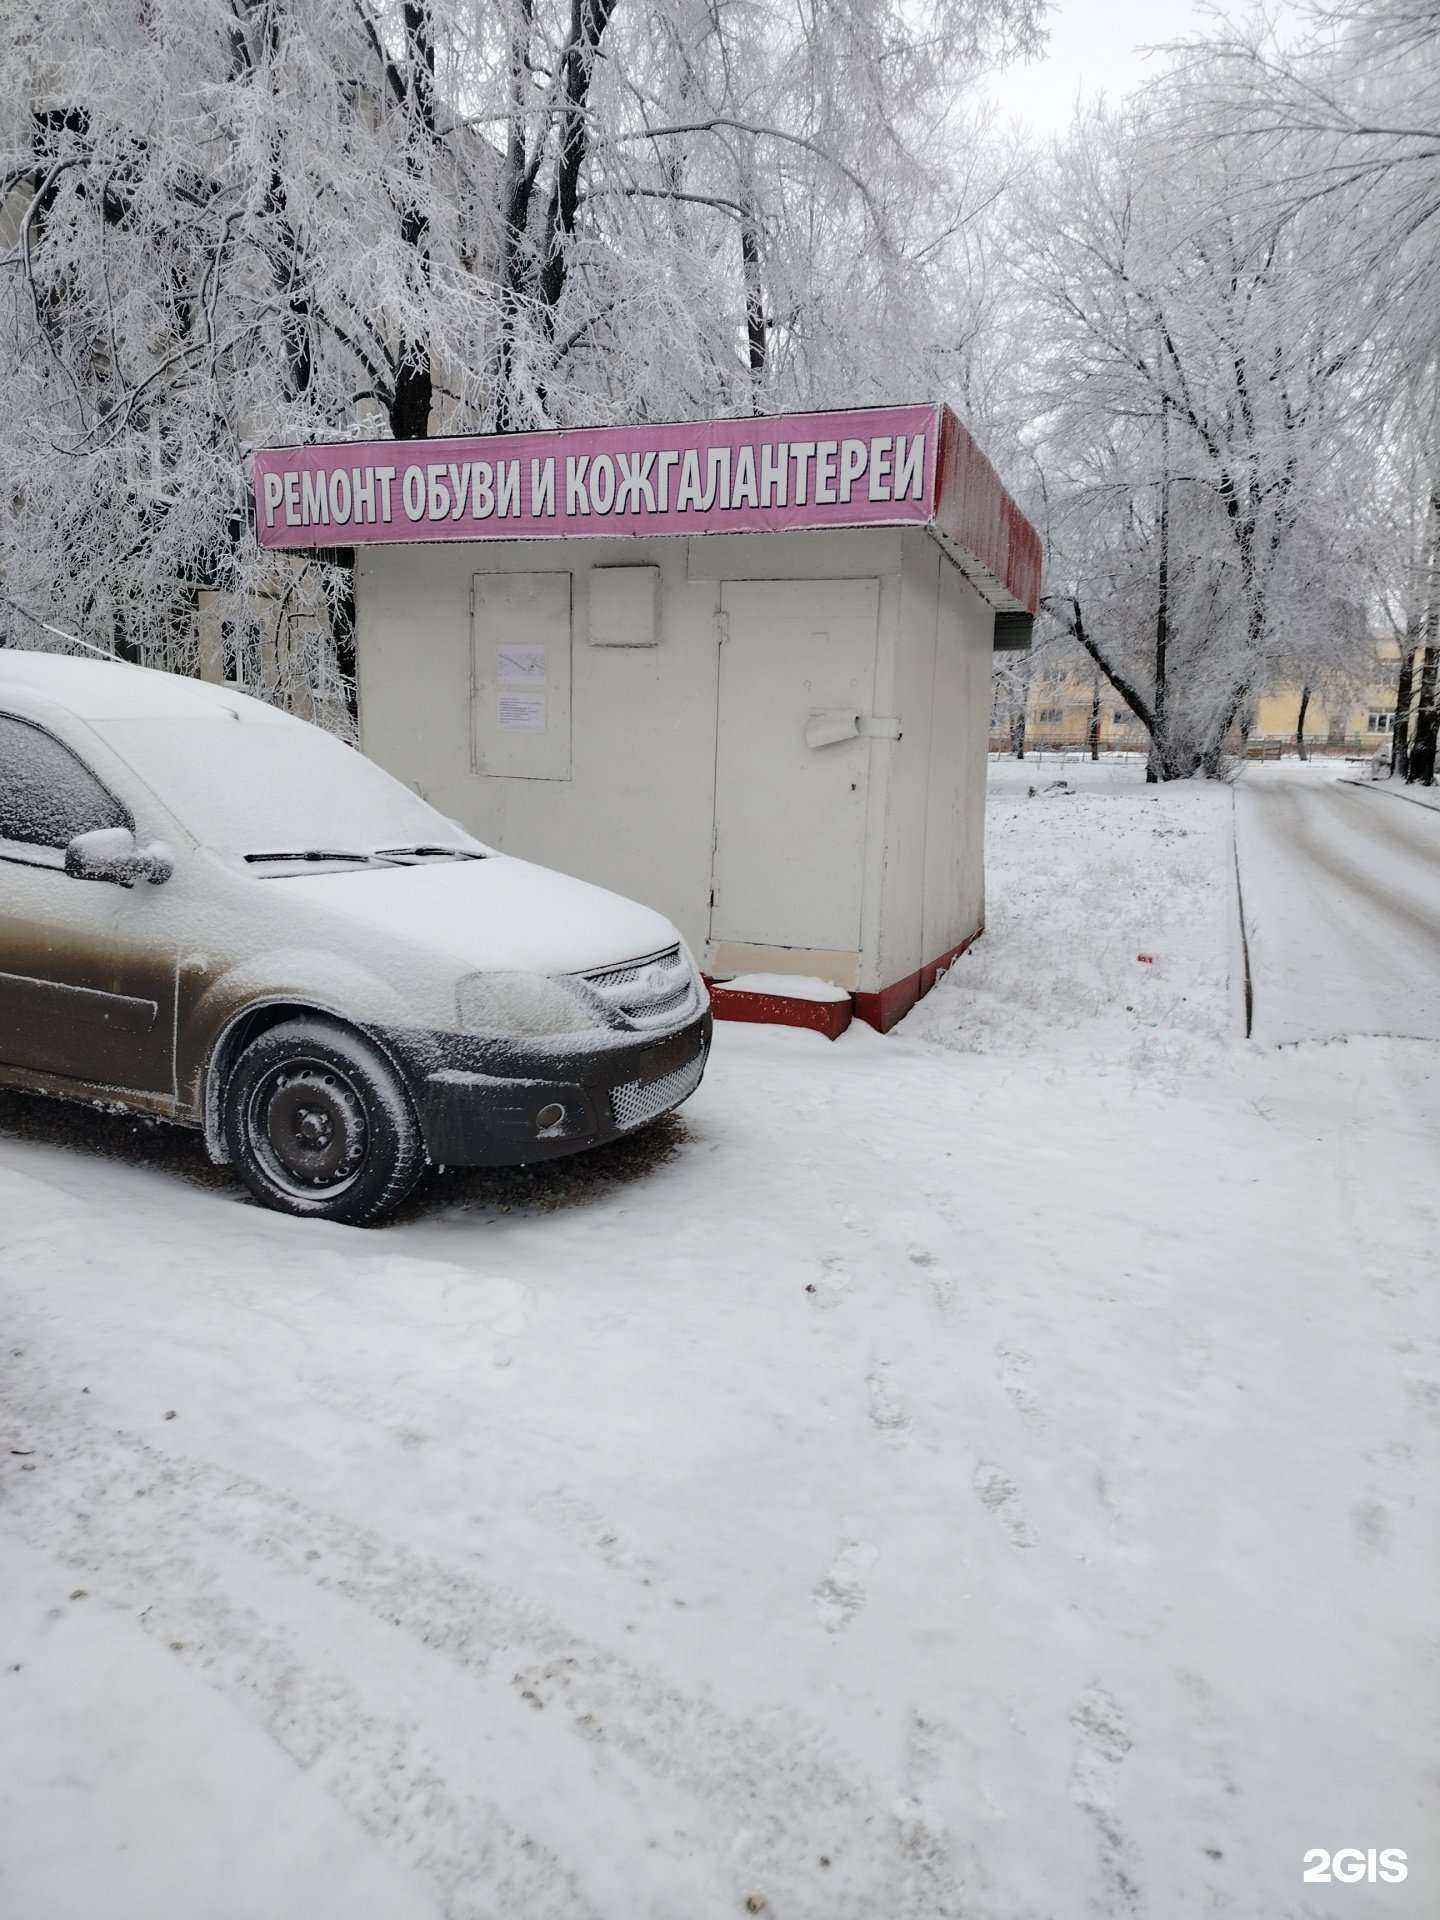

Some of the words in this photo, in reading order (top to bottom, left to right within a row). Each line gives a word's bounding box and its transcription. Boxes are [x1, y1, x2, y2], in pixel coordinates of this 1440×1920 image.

[264, 466, 396, 528] РЕМОНТ
[402, 459, 521, 522] ОБУВИ
[530, 456, 556, 517] И
[565, 433, 926, 517] КОЖГАЛАНТЕРЕИ
